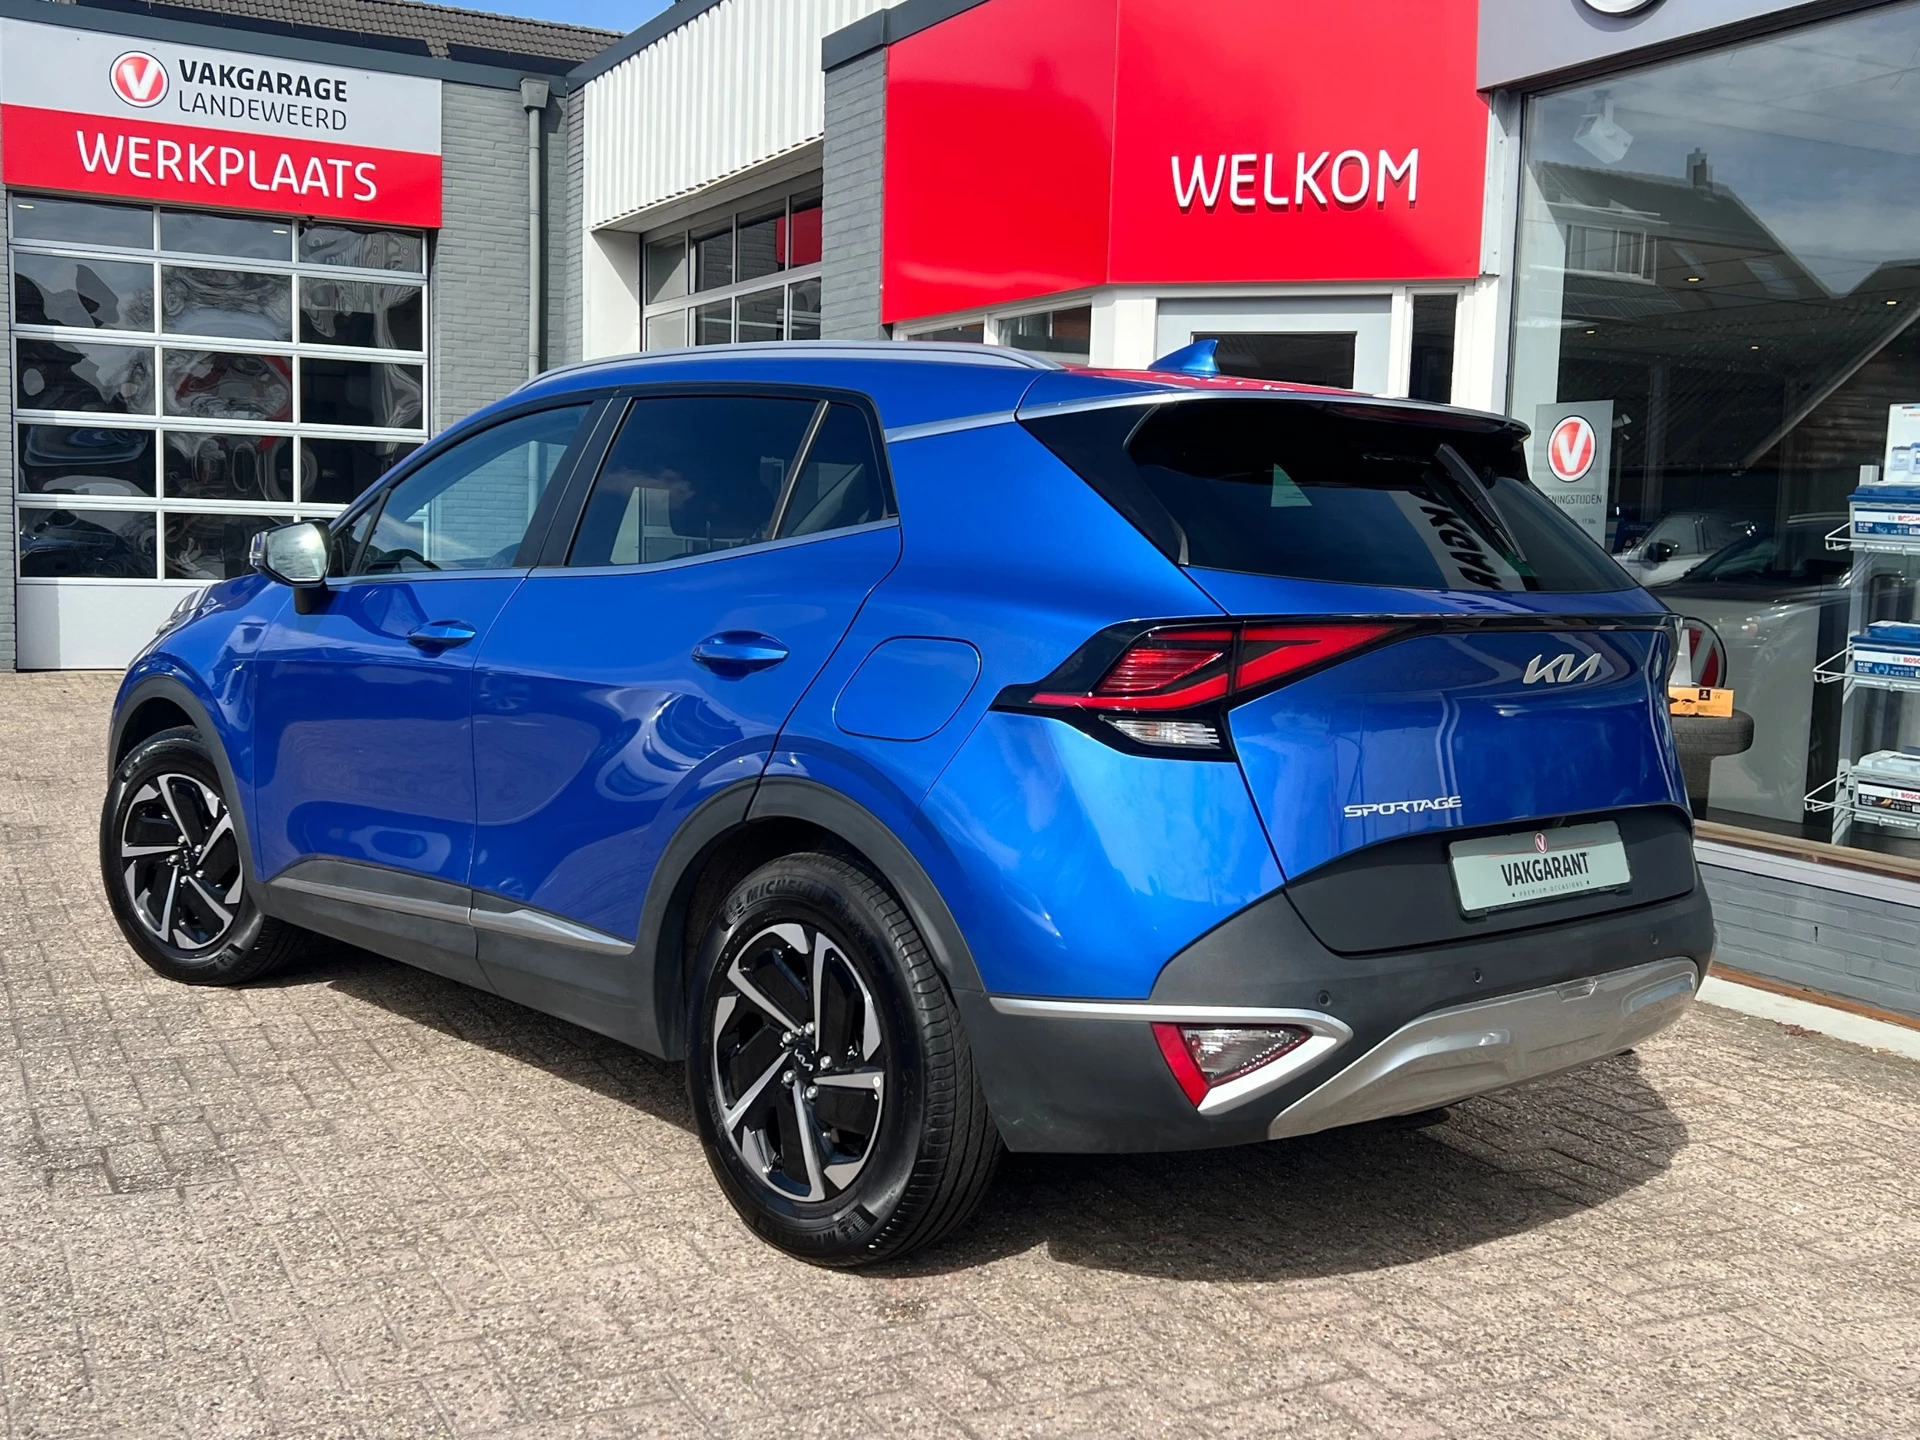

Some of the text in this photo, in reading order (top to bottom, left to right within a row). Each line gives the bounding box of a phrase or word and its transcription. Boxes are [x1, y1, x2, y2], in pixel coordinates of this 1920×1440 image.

[179, 58, 348, 103] VAKGARAGE
[179, 90, 347, 131] LANDEWEERD
[76, 130, 377, 202] WERKPLAATS
[1171, 148, 1419, 208] WELKOM
[1343, 796, 1463, 818] SPORTAGE
[1500, 852, 1589, 887] VAKGARANT
[1519, 880, 1584, 897] PREMIUM OCCASIONS
